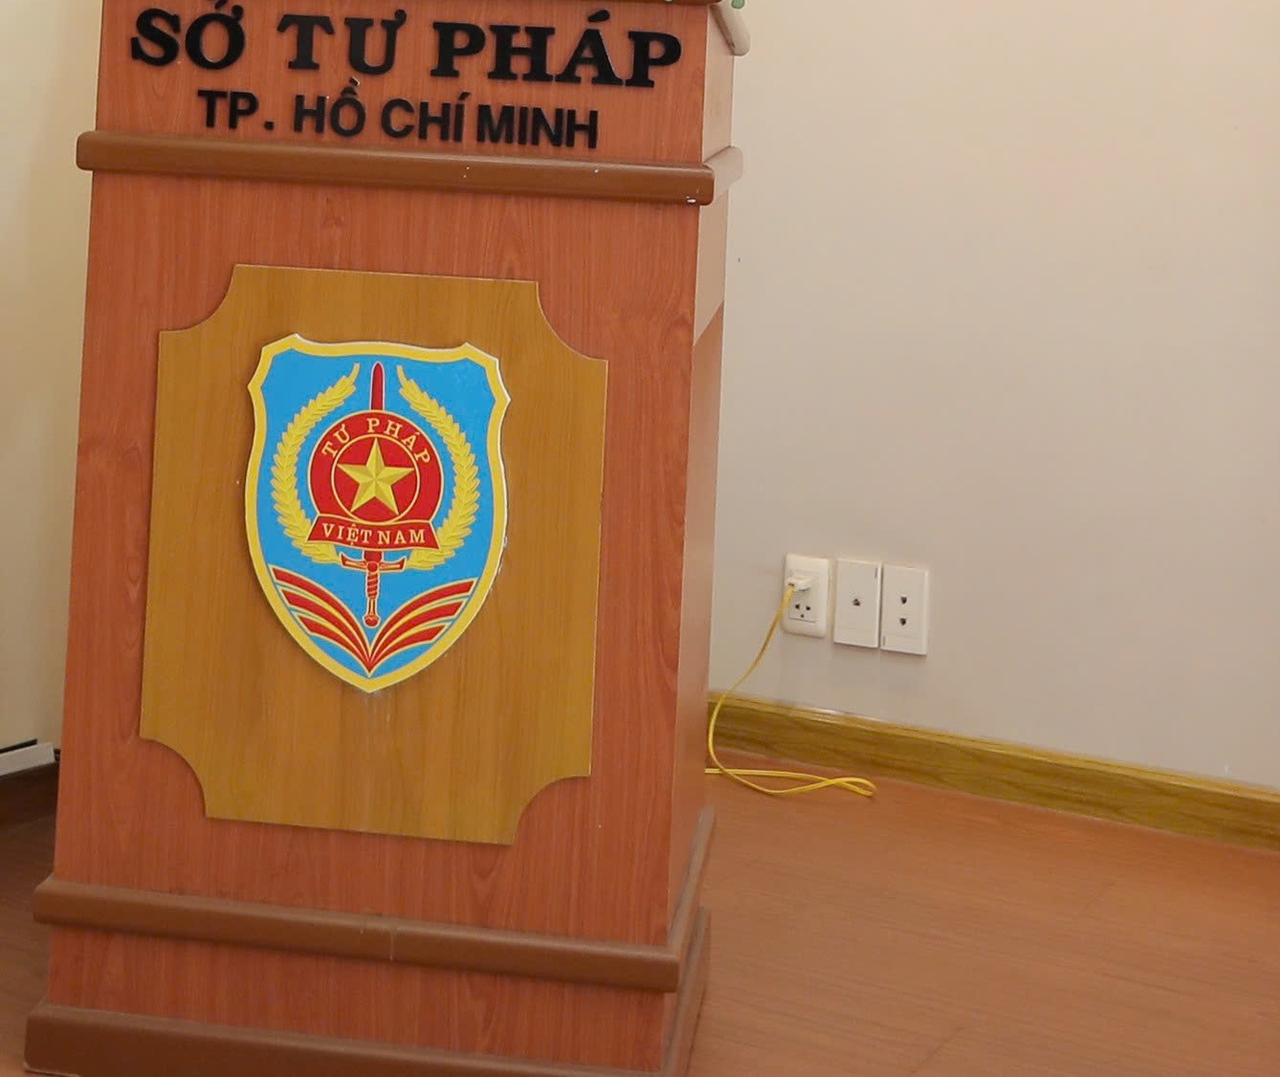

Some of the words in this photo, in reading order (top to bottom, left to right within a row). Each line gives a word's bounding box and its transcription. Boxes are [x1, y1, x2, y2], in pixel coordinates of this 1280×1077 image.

[277, 9, 407, 75] TƯ
[430, 10, 682, 88] PHÁP
[293, 77, 366, 138] HỒ
[381, 91, 470, 143] CHÍ
[477, 104, 598, 150] MINH
[321, 423, 351, 459] TƯ
[366, 417, 432, 466] PHÁP
[321, 522, 373, 545] VIỆT
[377, 528, 426, 546] NAM
